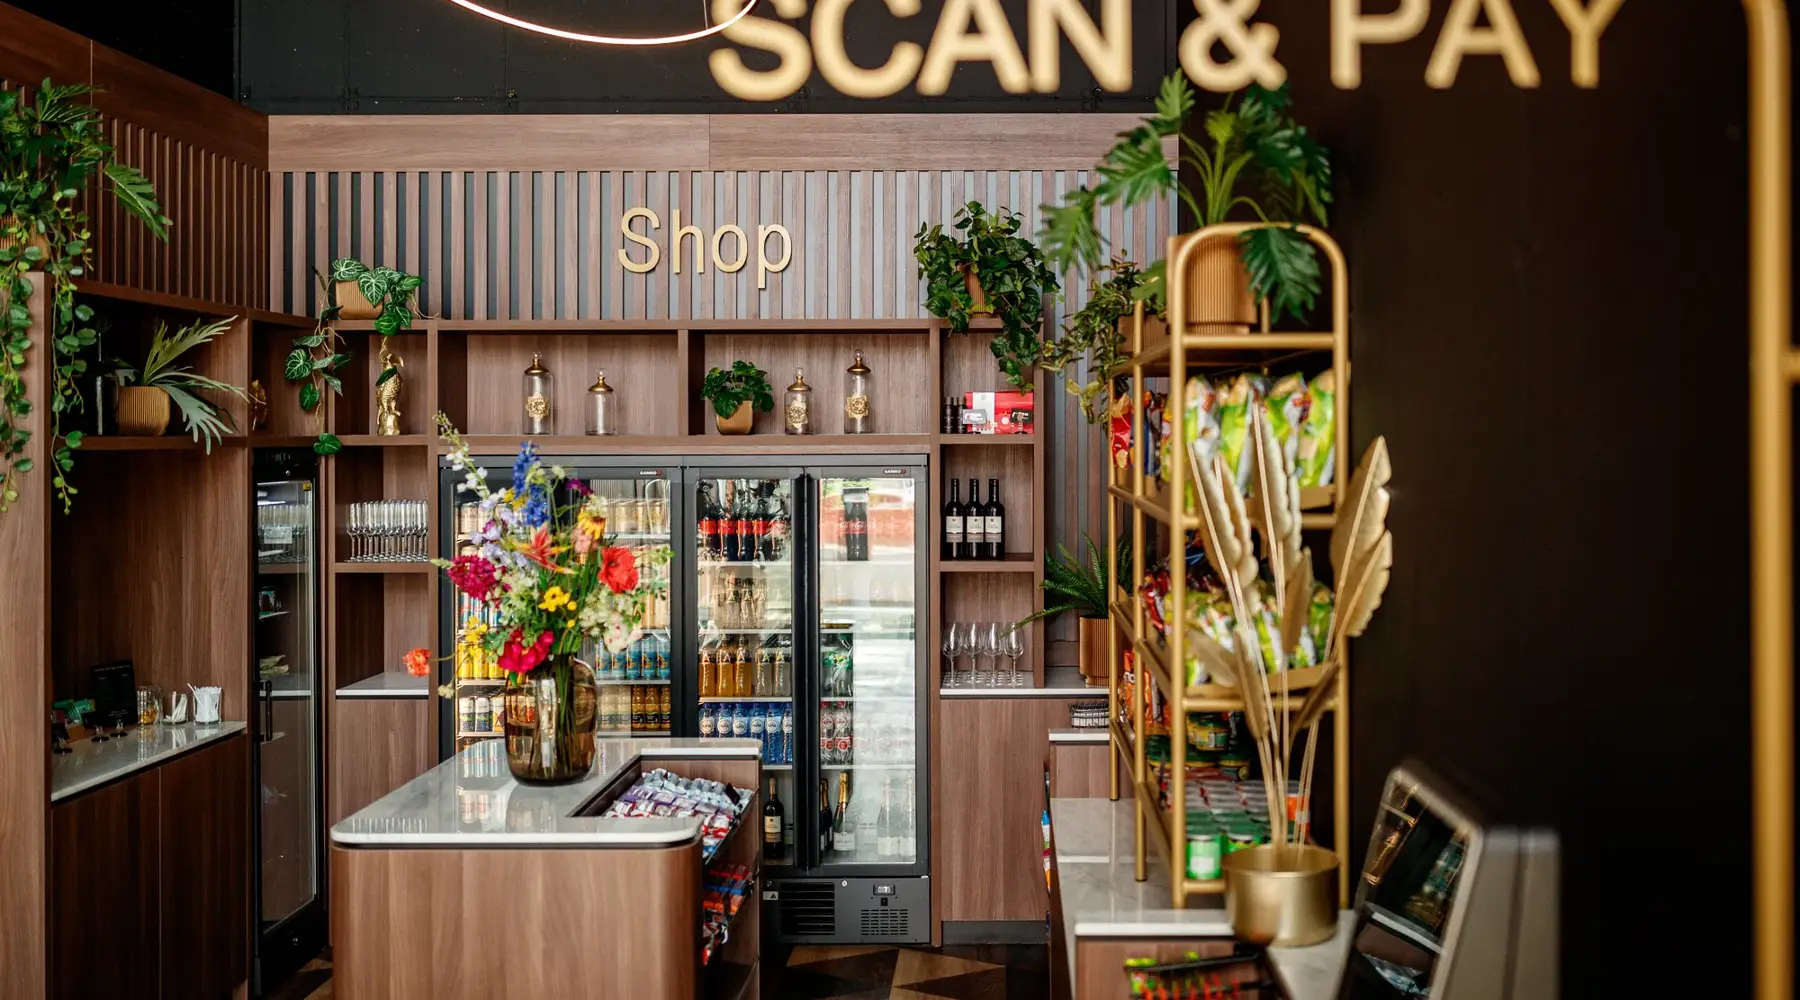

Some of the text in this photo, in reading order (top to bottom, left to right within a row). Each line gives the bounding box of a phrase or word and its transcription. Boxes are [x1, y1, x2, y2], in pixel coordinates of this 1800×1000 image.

[709, 0, 1626, 100] SCAN & PAY
[618, 207, 793, 290] Shop
